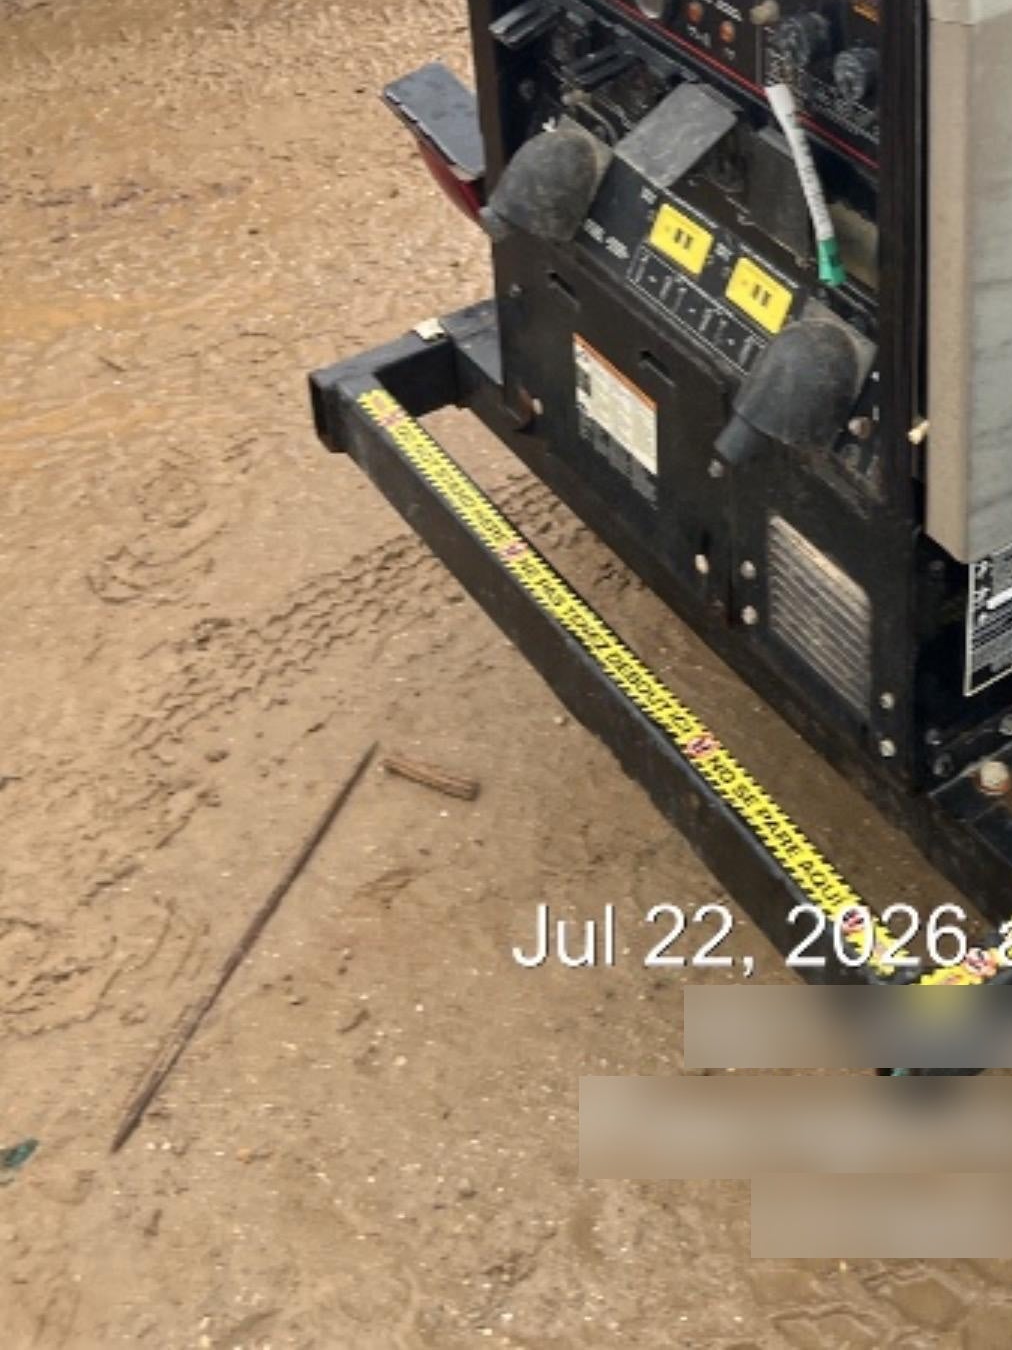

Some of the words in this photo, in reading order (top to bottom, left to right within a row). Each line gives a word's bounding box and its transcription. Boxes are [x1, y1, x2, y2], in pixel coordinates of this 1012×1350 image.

[605, 653, 671, 712] DEBOUT
[706, 755, 736, 784] NO
[731, 782, 760, 808] SE
[756, 806, 801, 858] PARE
